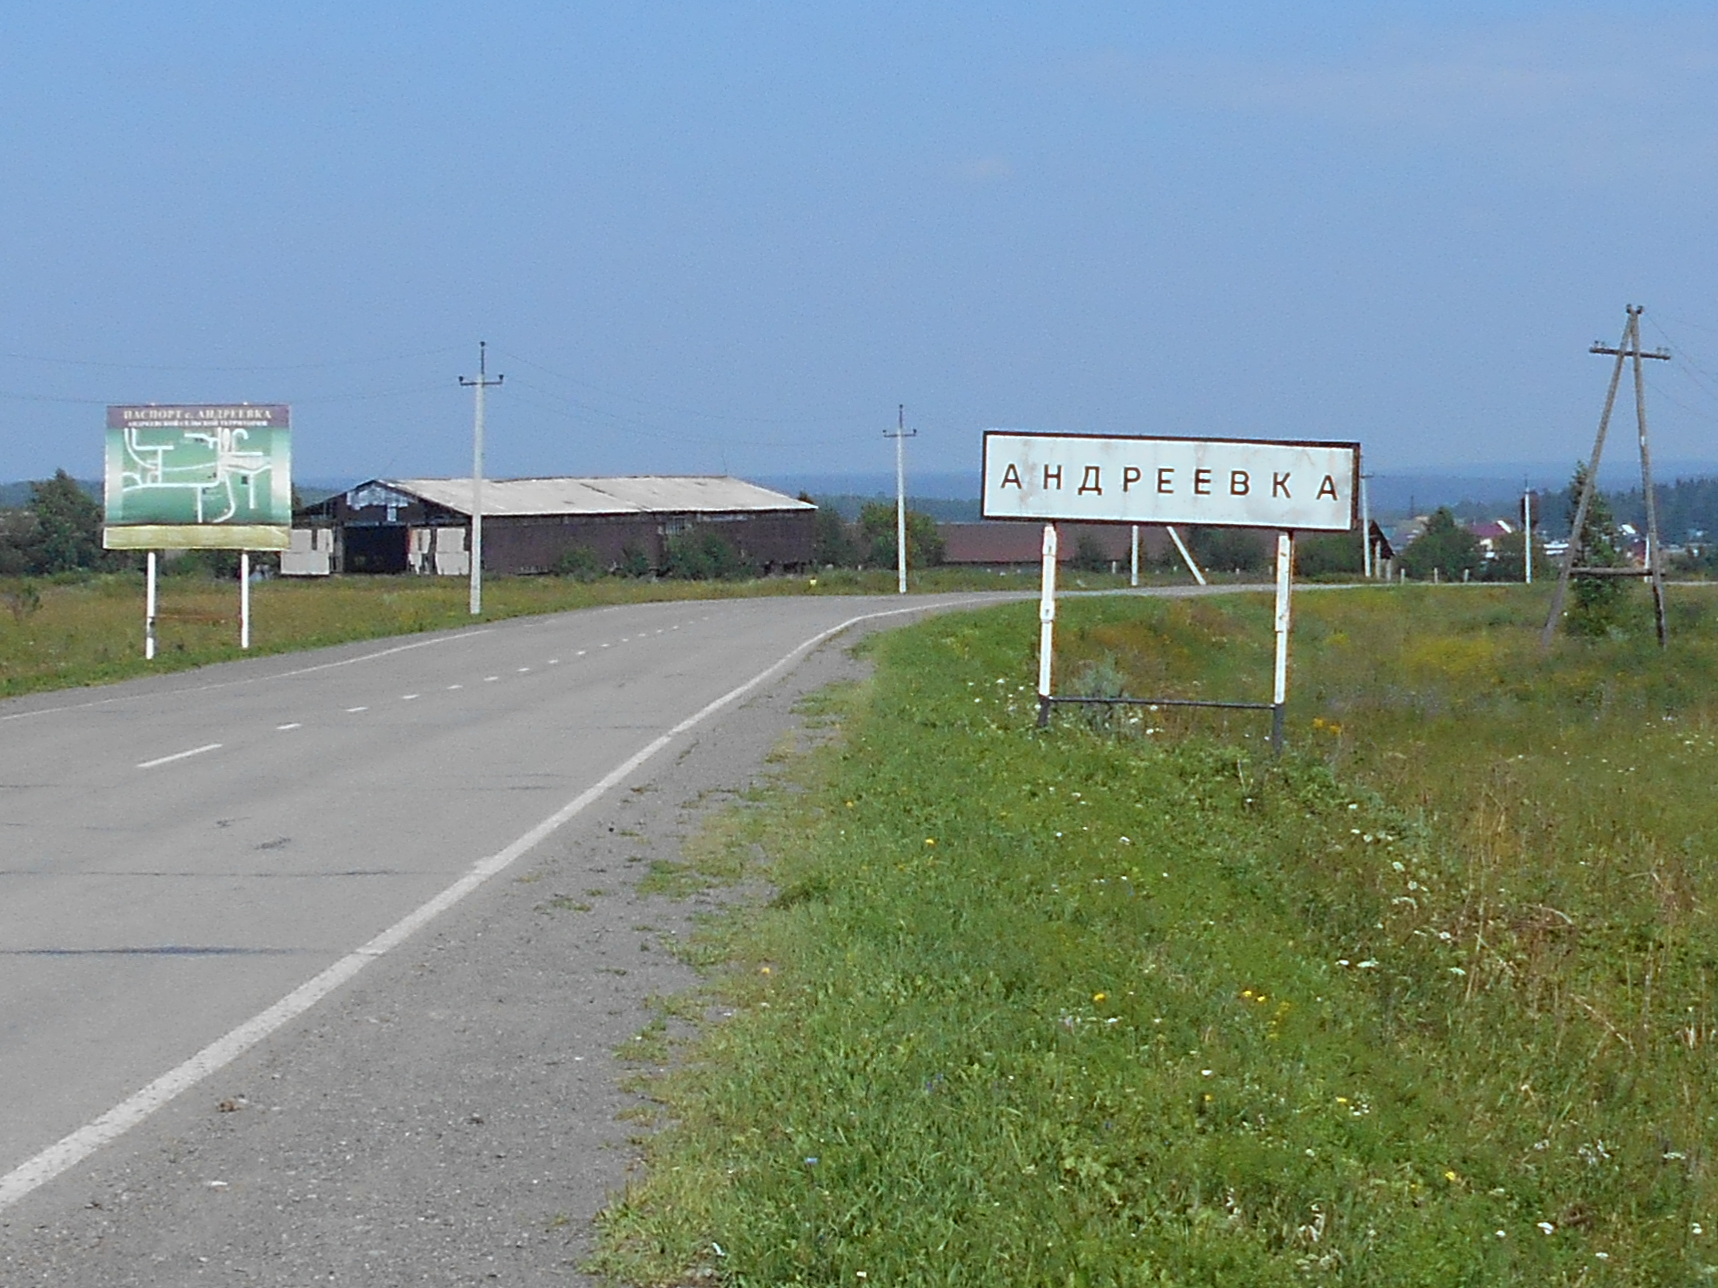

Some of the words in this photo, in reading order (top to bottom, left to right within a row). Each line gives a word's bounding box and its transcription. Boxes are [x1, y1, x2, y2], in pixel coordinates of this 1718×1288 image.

[124, 410, 181, 420] ПАСПОРТ
[198, 409, 272, 420] АНДРЕЕВКА
[1000, 463, 1339, 501] АНДРЕЕВКА
